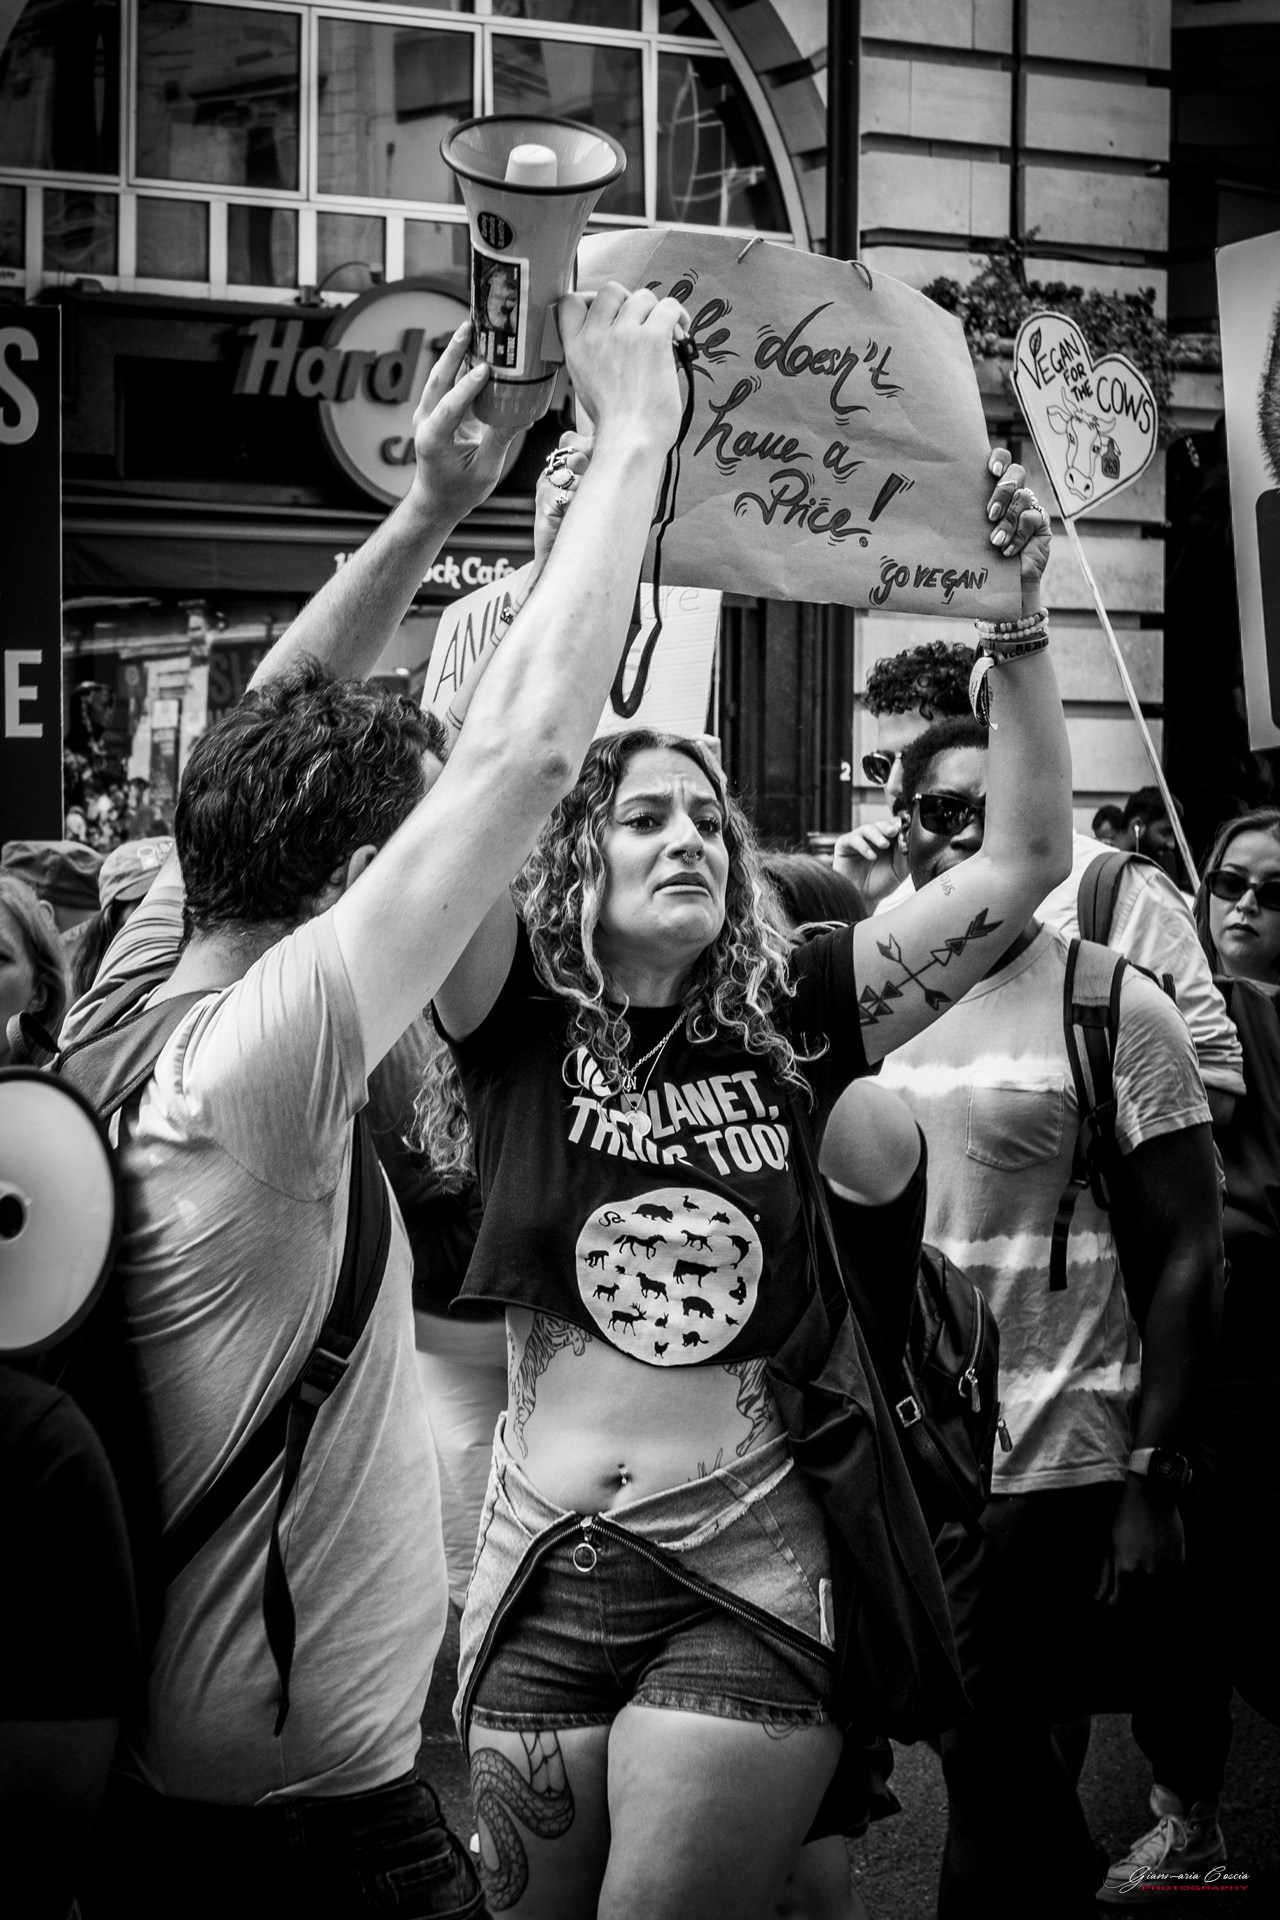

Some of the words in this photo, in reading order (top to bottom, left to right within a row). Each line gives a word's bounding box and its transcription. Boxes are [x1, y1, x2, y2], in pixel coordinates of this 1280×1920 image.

[234, 317, 426, 405] Hard
[755, 302, 904, 415] doesn't
[1020, 327, 1081, 391] VEGAN
[1063, 362, 1087, 386] FOR
[1071, 379, 1094, 403] THE
[1097, 376, 1152, 434] COWS
[823, 440, 867, 475] a
[733, 468, 905, 548] Price!
[913, 564, 987, 598] VEGAN
